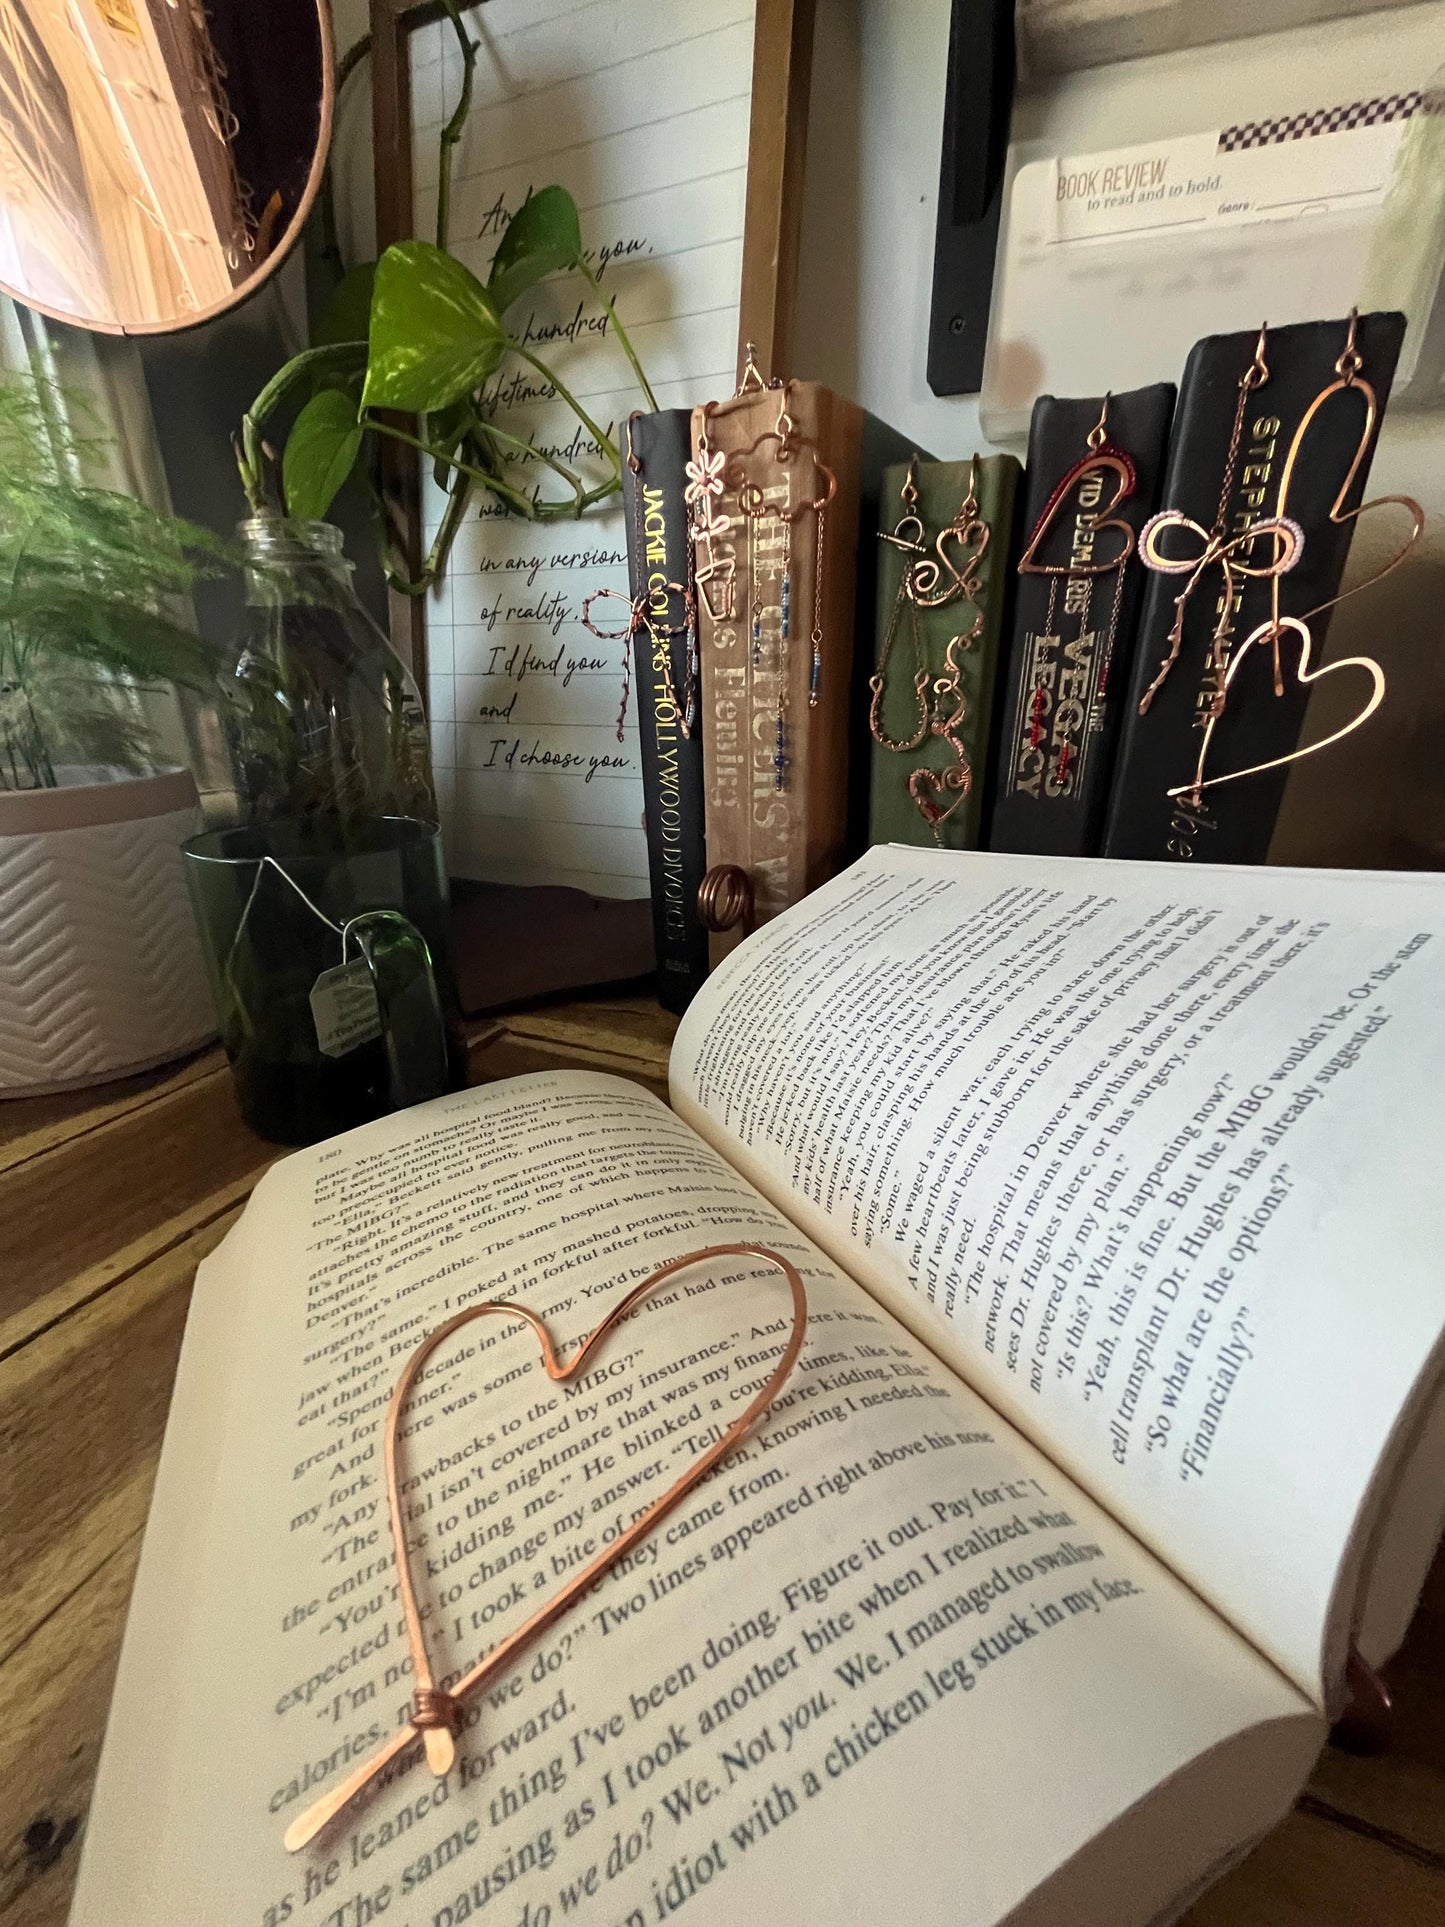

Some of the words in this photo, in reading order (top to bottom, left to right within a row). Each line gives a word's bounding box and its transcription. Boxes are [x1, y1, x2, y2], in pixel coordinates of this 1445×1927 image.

[478, 185, 533, 239] An
[1057, 168, 1100, 202] BOOK
[1102, 157, 1169, 193] REVIEW
[522, 295, 616, 348] hundred
[522, 421, 613, 464] hundred
[643, 484, 667, 566] JACKIE
[480, 557, 503, 572] in
[505, 555, 547, 586] any
[550, 545, 629, 570] version
[480, 593, 502, 631] of
[522, 644, 565, 681] find
[563, 657, 608, 687] you
[480, 692, 517, 724] and
[710, 666, 746, 808] Fleming
[1016, 634, 1062, 800] LEGACY
[1044, 630, 1096, 799] VEGAS
[520, 740, 585, 768] choose
[653, 683, 682, 842] HOLLYWOOD
[977, 1182, 1017, 1258] hospital
[1009, 1163, 1030, 1183] in
[1023, 1102, 1072, 1160] Denver
[1069, 1060, 1111, 1101] where
[1108, 1036, 1133, 1058] she
[1126, 1011, 1159, 1035] had
[1152, 992, 1180, 1011] her
[1178, 953, 1230, 991] surgery
[1108, 1284, 1137, 1327] this
[1125, 1261, 1148, 1282] is
[1138, 1215, 1176, 1259] fine.
[1166, 1173, 1203, 1211] But
[1195, 1141, 1227, 1170] the
[1216, 1084, 1274, 1139] MIBG
[1322, 1003, 1359, 1021] be.
[1348, 982, 1379, 999] Or
[1369, 962, 1401, 981] the
[1395, 933, 1433, 960] stem
[1261, 1084, 1325, 1146] already
[427, 1182, 490, 1212] relatively
[492, 1171, 519, 1186] new
[522, 1150, 585, 1175] treatment
[1229, 1148, 1268, 1180] has
[1057, 1246, 1083, 1273] by
[1066, 1294, 1093, 1350] this?
[1119, 1124, 1202, 1219] happening
[1075, 1212, 1100, 1245] my
[1177, 1182, 1242, 1261] Hughes
[944, 1267, 962, 1319] really
[953, 1218, 977, 1267] need.
[1157, 1268, 1190, 1302] Dr.
[1035, 1273, 1068, 1358] covered
[1162, 1350, 1195, 1409] what
[1186, 1308, 1213, 1348] are
[1203, 1266, 1235, 1304] the
[1029, 1358, 1043, 1394] not
[1117, 1304, 1170, 1422] transplant
[1110, 1419, 1130, 1466] cell
[593, 1594, 647, 1637] Two
[650, 1552, 707, 1602] lines
[710, 1487, 815, 1563] appeared
[815, 1461, 868, 1499] right
[862, 1439, 927, 1472] above
[400, 1818, 481, 1895] same
[489, 1758, 567, 1827] thing
[629, 1662, 698, 1721] been
[701, 1608, 781, 1670] doing.
[780, 1552, 864, 1613] Figure
[862, 1538, 886, 1560] it
[888, 1516, 934, 1547] out.
[930, 1497, 975, 1524] Pay
[431, 1828, 557, 1927] pausing
[564, 1799, 596, 1838] as
[601, 1769, 619, 1809] I
[625, 1724, 691, 1789] took
[698, 1646, 800, 1736] another
[801, 1611, 856, 1654] bite
[858, 1568, 925, 1617] when
[921, 1552, 942, 1576] I
[943, 1515, 1031, 1567] realized
[559, 1864, 600, 1915] we
[606, 1806, 655, 1881] do?
[660, 1778, 722, 1825] We.
[719, 1727, 777, 1785] Not
[780, 1691, 837, 1752] you.
[834, 1653, 891, 1690] We.
[885, 1630, 907, 1660] I
[905, 1567, 1012, 1649] managed
[1007, 1563, 1035, 1585] to
[1032, 1542, 1105, 1575] swallow
[350, 1774, 450, 1869] leaned
[459, 1688, 576, 1789] forward.
[652, 1839, 727, 1923] idiot
[730, 1782, 799, 1852] with
[802, 1771, 822, 1798] a
[825, 1689, 930, 1778] chicken
[924, 1659, 976, 1699] leg
[971, 1612, 1040, 1670] stuck
[1031, 1601, 1066, 1627] in
[1062, 1588, 1102, 1613] my
